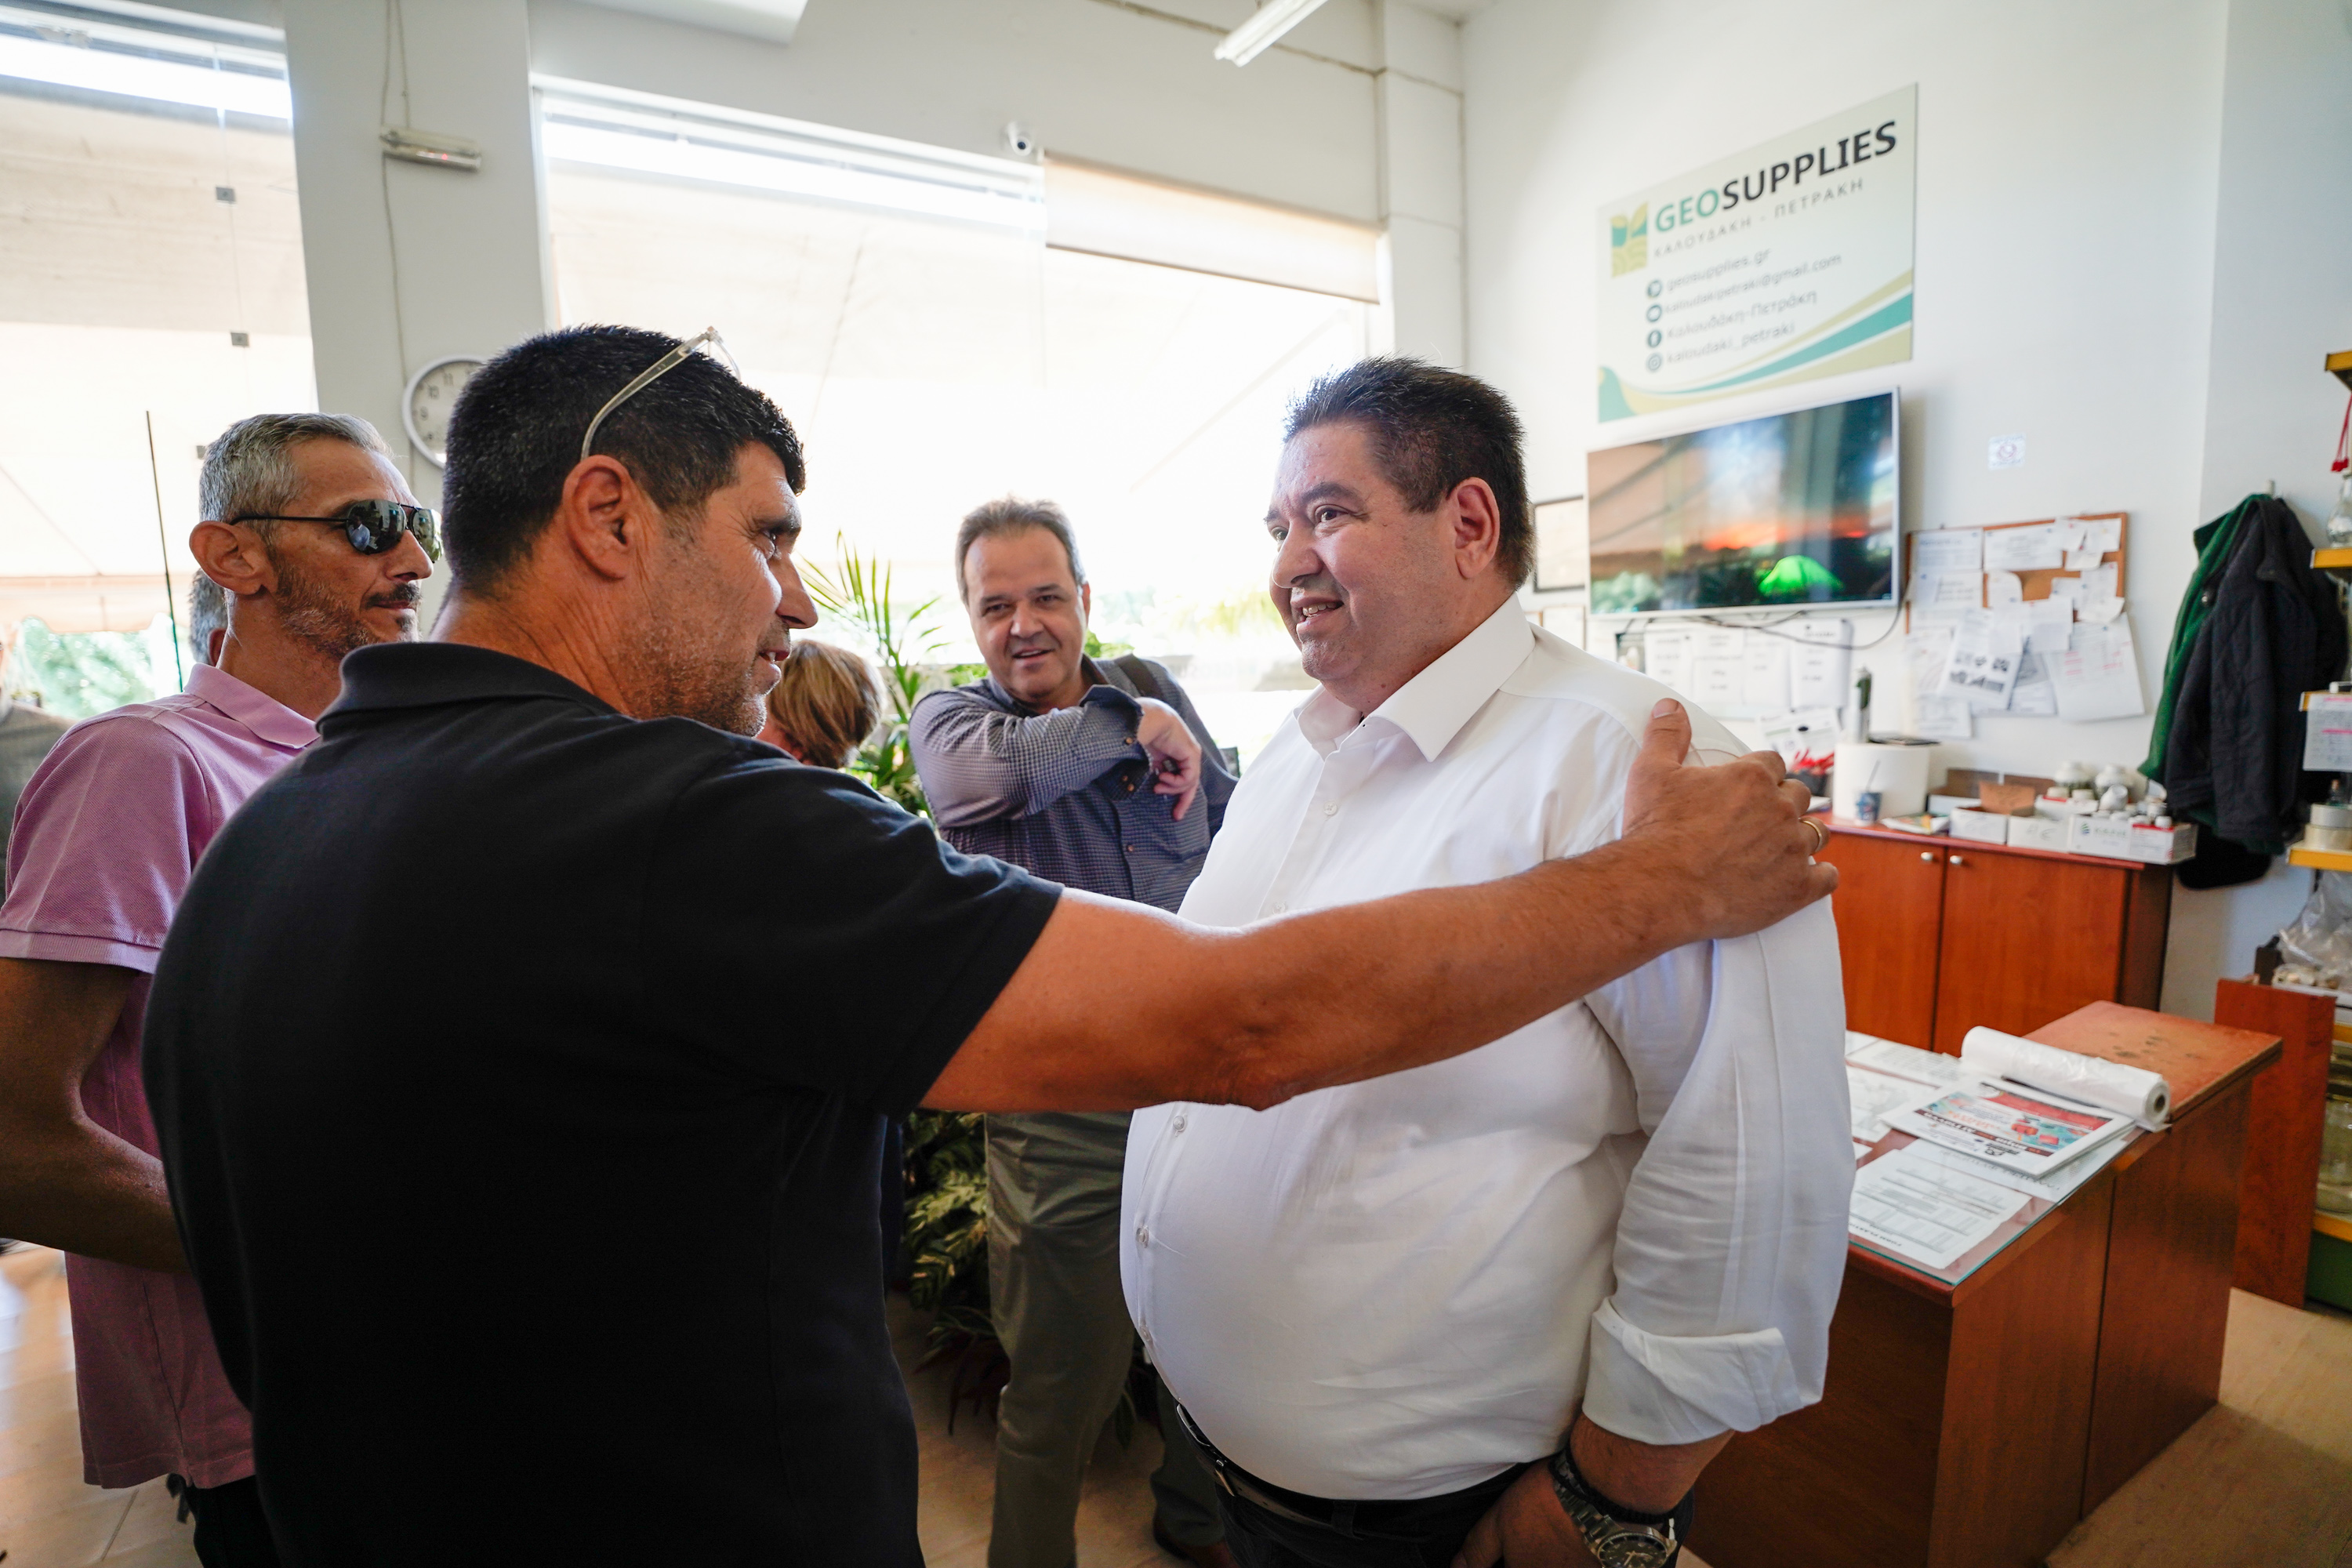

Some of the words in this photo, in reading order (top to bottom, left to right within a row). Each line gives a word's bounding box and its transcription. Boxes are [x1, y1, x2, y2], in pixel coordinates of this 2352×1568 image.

[1656, 120, 1896, 232] GEOSUPPLIES
[1654, 215, 1751, 258] ΚΑΛΟΥΔΑΚΗ
[1774, 177, 1863, 219] ΠΕΤΡΑΚΗ
[1667, 249, 1771, 292] geosupplies.gr
[419, 405, 429, 421] 9
[428, 385, 440, 400] 10
